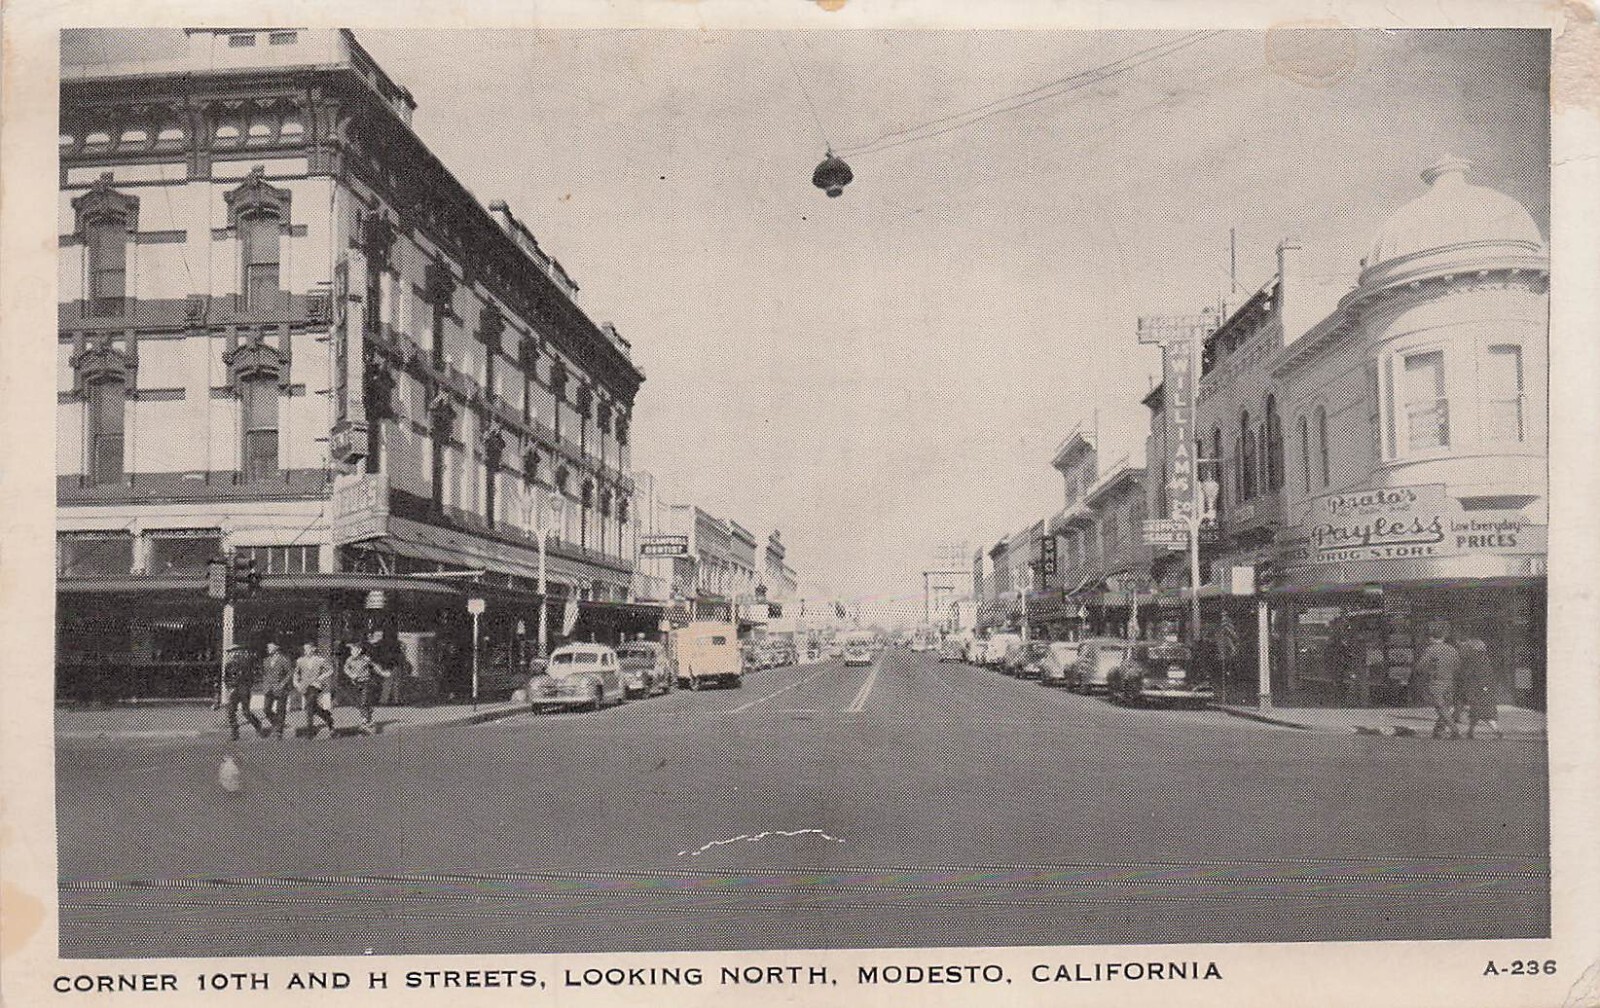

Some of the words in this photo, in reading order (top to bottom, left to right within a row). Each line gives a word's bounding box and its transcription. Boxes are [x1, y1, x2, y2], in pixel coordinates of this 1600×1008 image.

[1171, 358, 1190, 492] WILLIAMS
[1311, 515, 1445, 547] Payless
[1456, 533, 1517, 548] PRICES
[1316, 550, 1361, 562] DRUG
[1370, 546, 1436, 559] STORE
